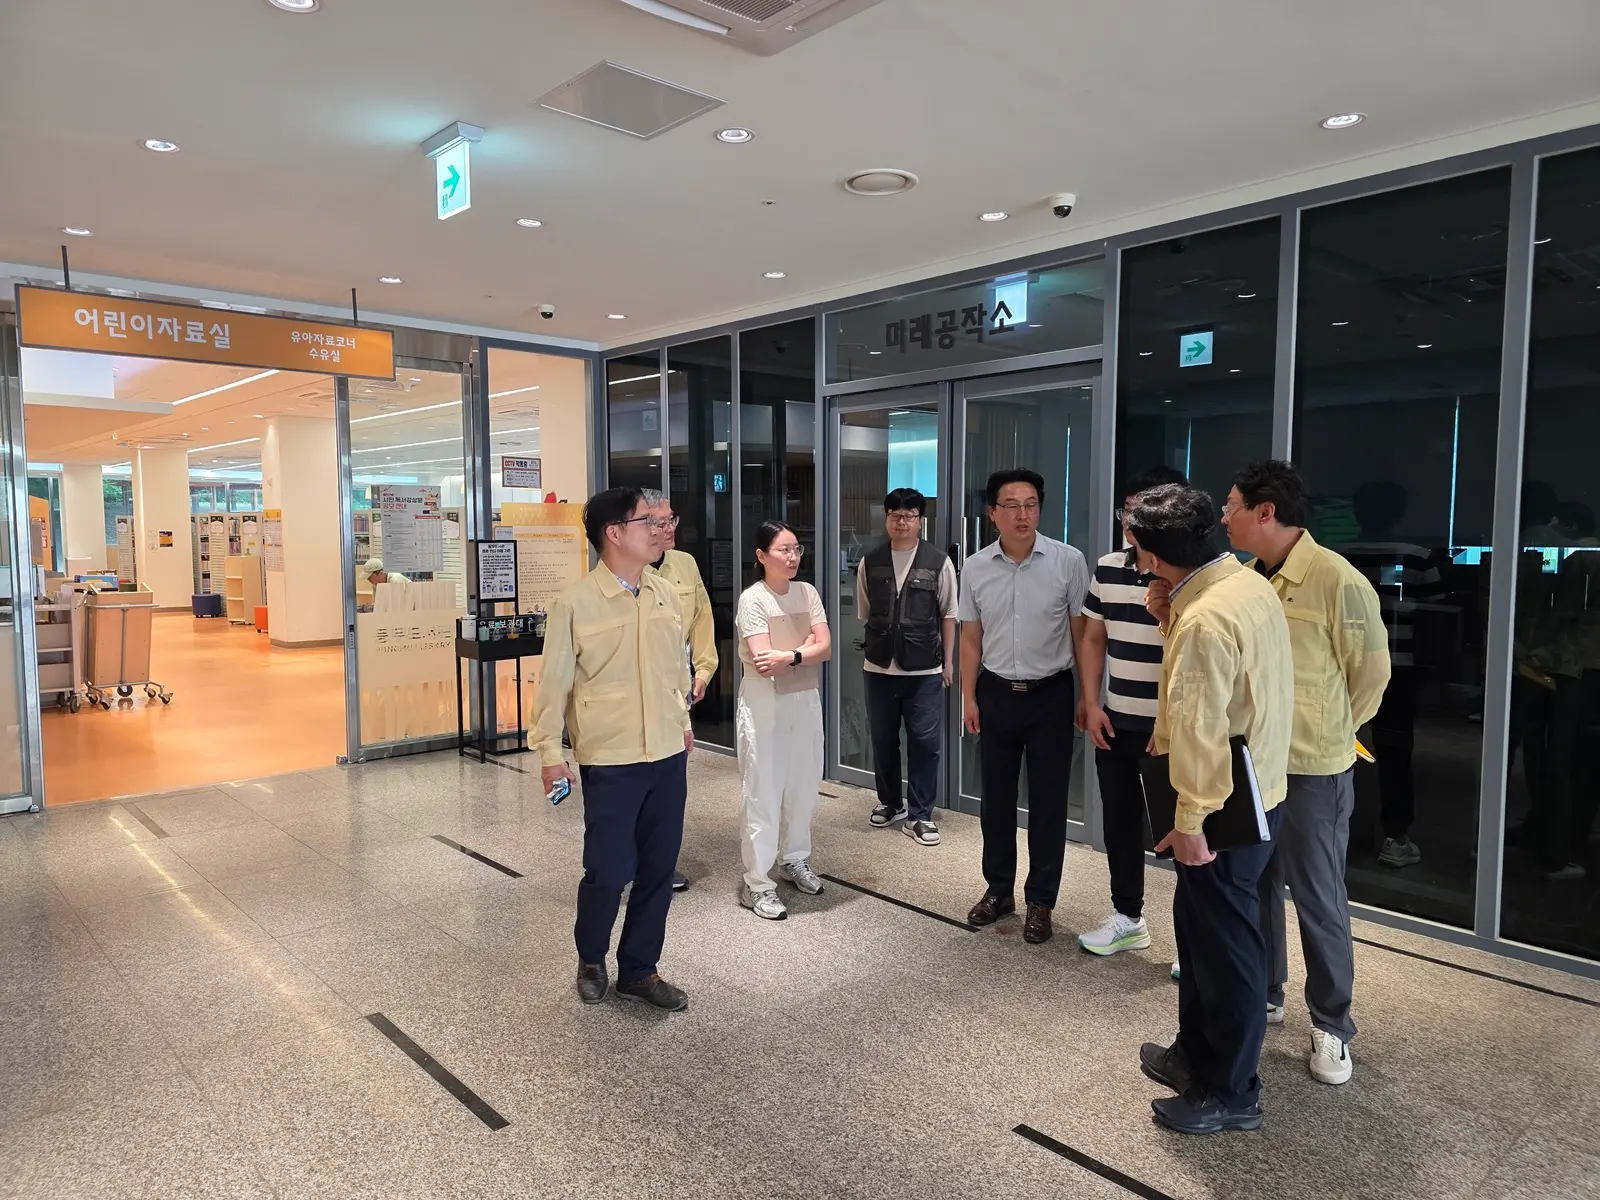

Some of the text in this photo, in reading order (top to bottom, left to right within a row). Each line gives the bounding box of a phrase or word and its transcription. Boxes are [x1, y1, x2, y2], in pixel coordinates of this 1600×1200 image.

[74, 308, 230, 349] 어린이자료실
[291, 331, 356, 349] 유아자료코너
[886, 301, 1015, 353] 미래공작소
[308, 348, 341, 363] 수유실
